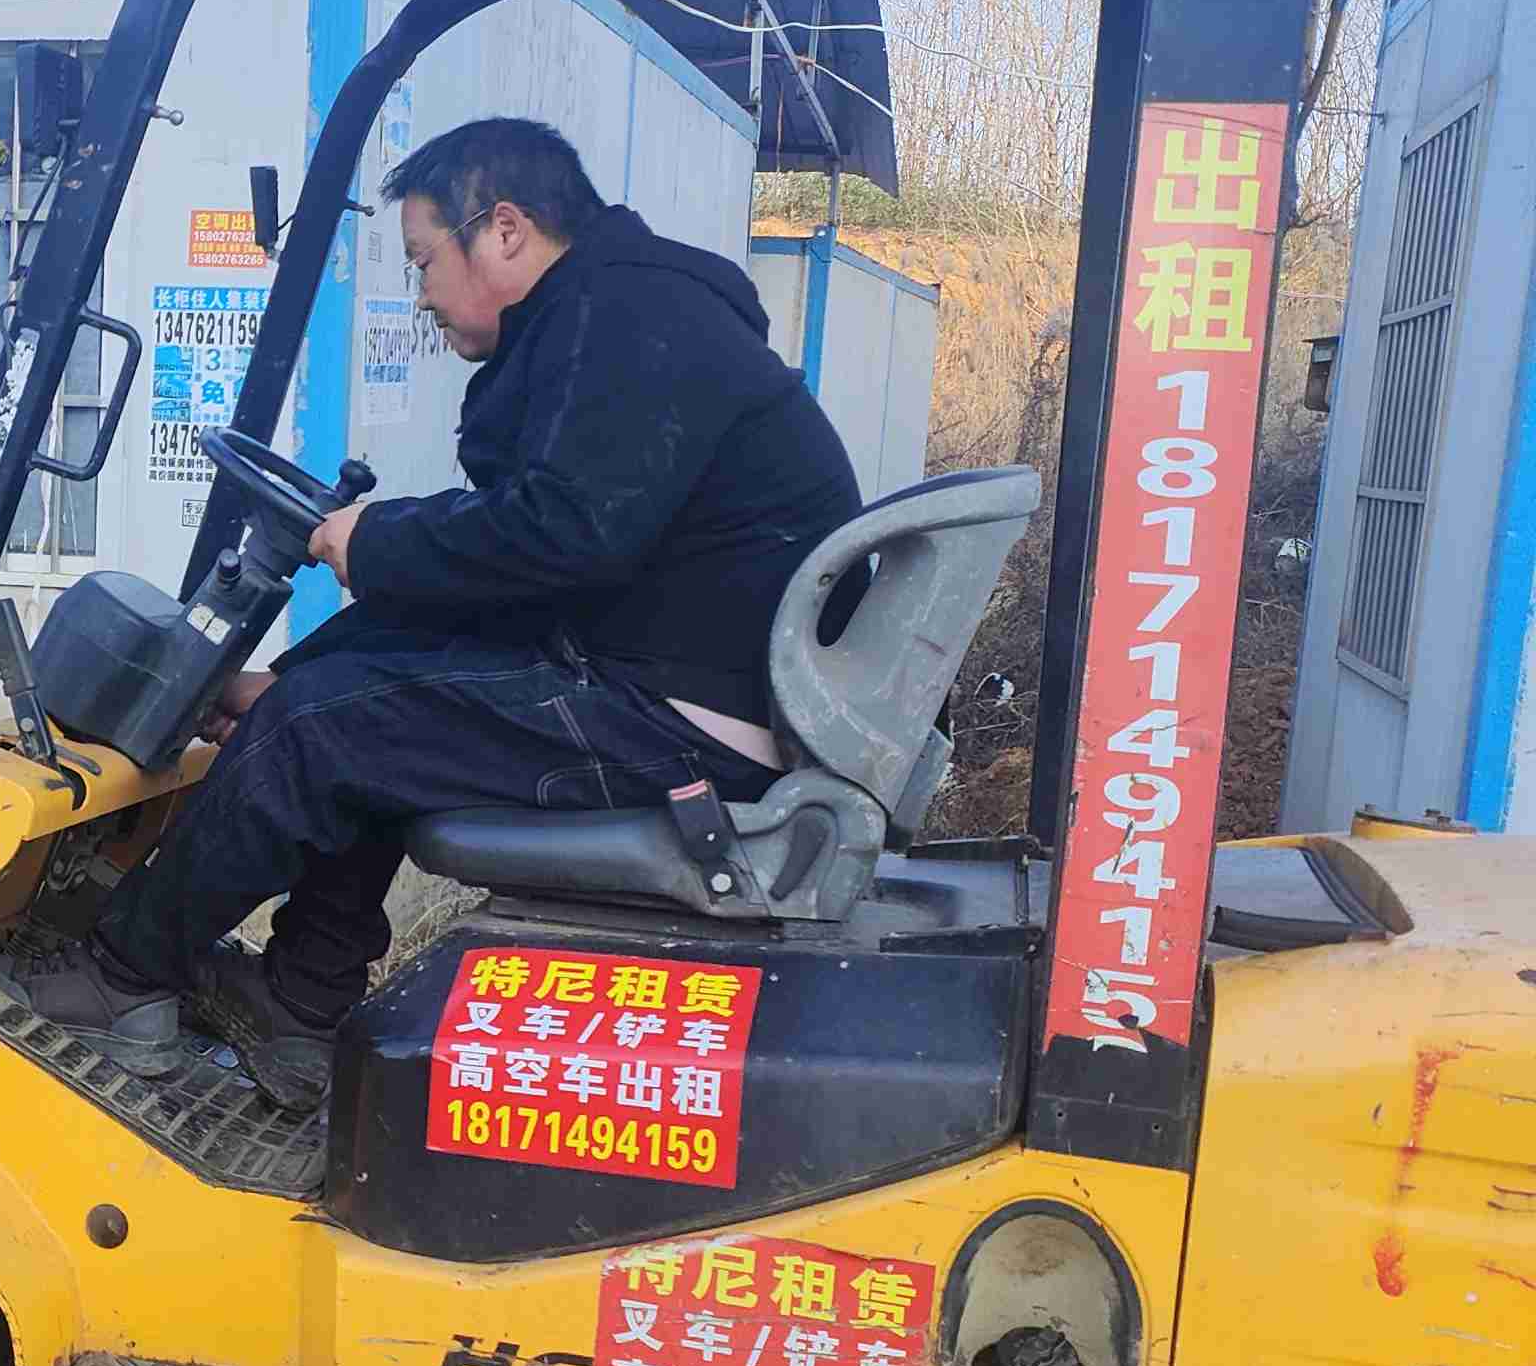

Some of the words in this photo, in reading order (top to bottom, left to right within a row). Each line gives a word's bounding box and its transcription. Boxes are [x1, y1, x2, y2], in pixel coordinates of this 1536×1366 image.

[195, 212, 255, 230] 空调出
[1133, 117, 1262, 353] 出租
[1081, 370, 1218, 1053] 1817149415
[470, 955, 741, 1017] 特尼租赁
[455, 1001, 731, 1056] 叉车/铲车
[449, 1042, 723, 1118] 高空车出租
[447, 1099, 717, 1173] 18171494159
[618, 1243, 917, 1338] 特尼租赁
